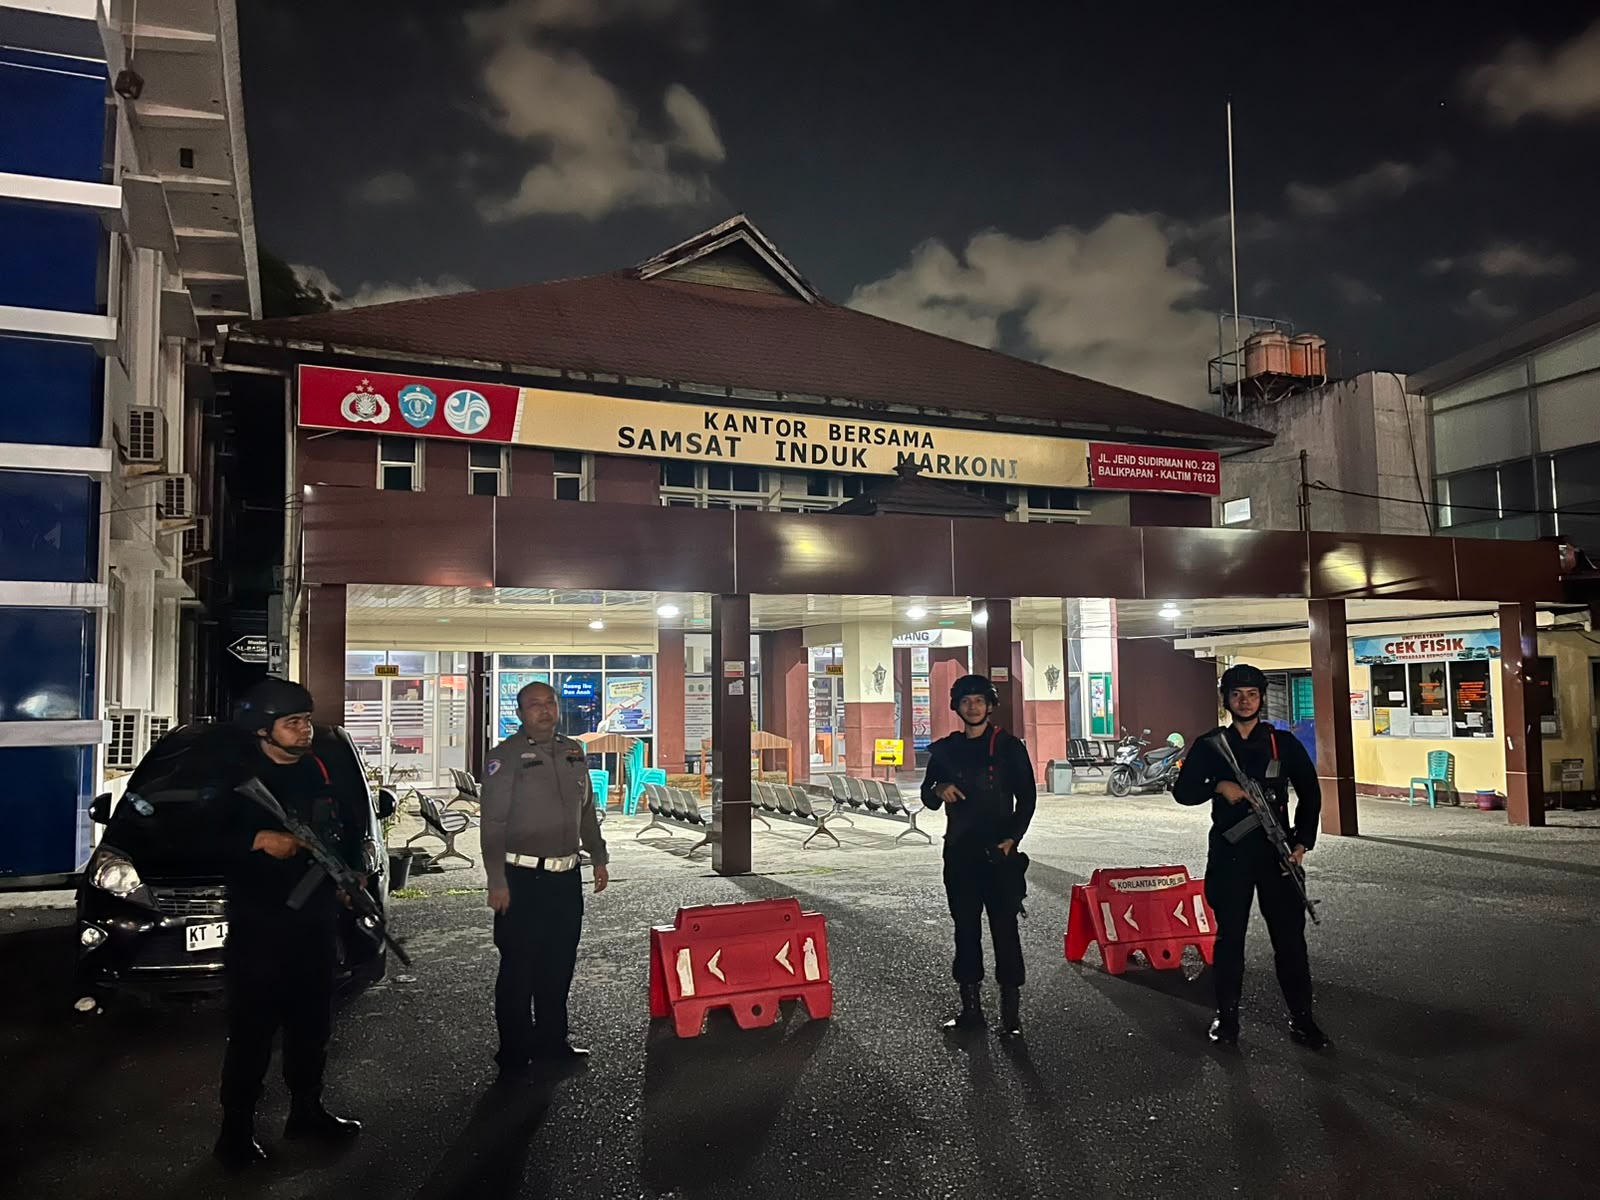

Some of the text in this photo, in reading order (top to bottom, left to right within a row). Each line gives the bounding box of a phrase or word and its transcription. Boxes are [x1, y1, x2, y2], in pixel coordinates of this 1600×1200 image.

[704, 411, 934, 449] KANTOR BERSAMA
[618, 426, 741, 458] SAMSAT
[775, 440, 867, 468] INDUK
[1098, 453, 1216, 471] JL. JEND SUDIRMAN NO. 229
[1098, 466, 1153, 478] BALIKPAPAN
[1160, 470, 1191, 481] KALTIM
[1193, 473, 1216, 483] 76123
[1384, 638, 1465, 654] CEK FISIK
[1117, 878, 1176, 889] KORLANTAS POLRI
[190, 926, 207, 942] KT
